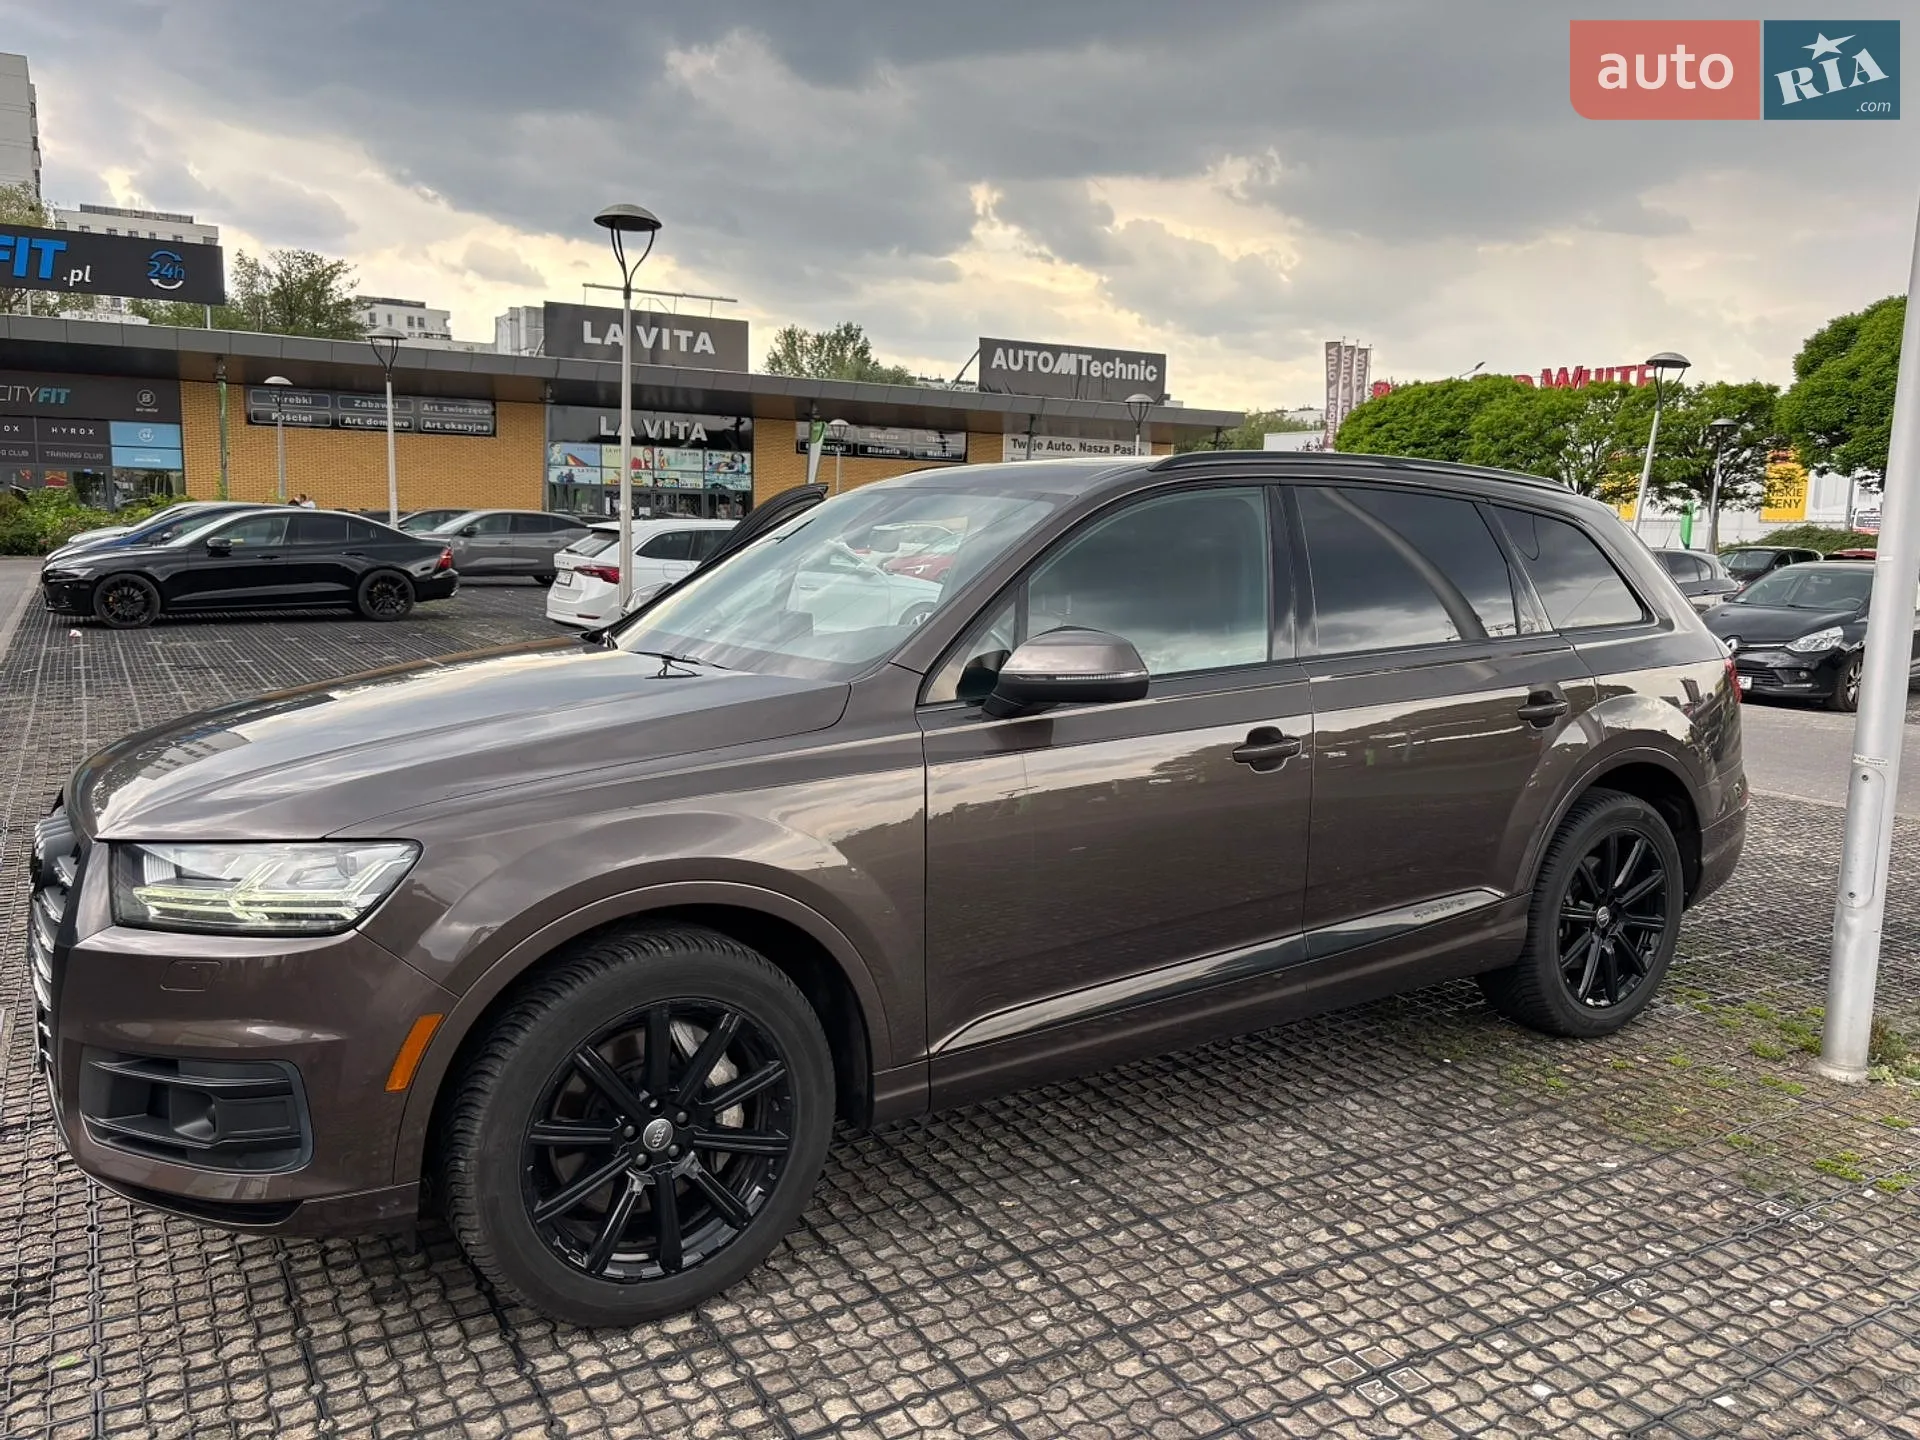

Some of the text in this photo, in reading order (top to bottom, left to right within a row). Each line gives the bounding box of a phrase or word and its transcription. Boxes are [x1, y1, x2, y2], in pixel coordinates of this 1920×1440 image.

[147, 260, 185, 280] 24h
[582, 319, 716, 355] LA VITA
[354, 399, 400, 410] Zabawi
[366, 416, 410, 428] domwe
[642, 417, 708, 442] VITA
[1011, 438, 1043, 451] Twje
[1046, 440, 1076, 452] Auto.
